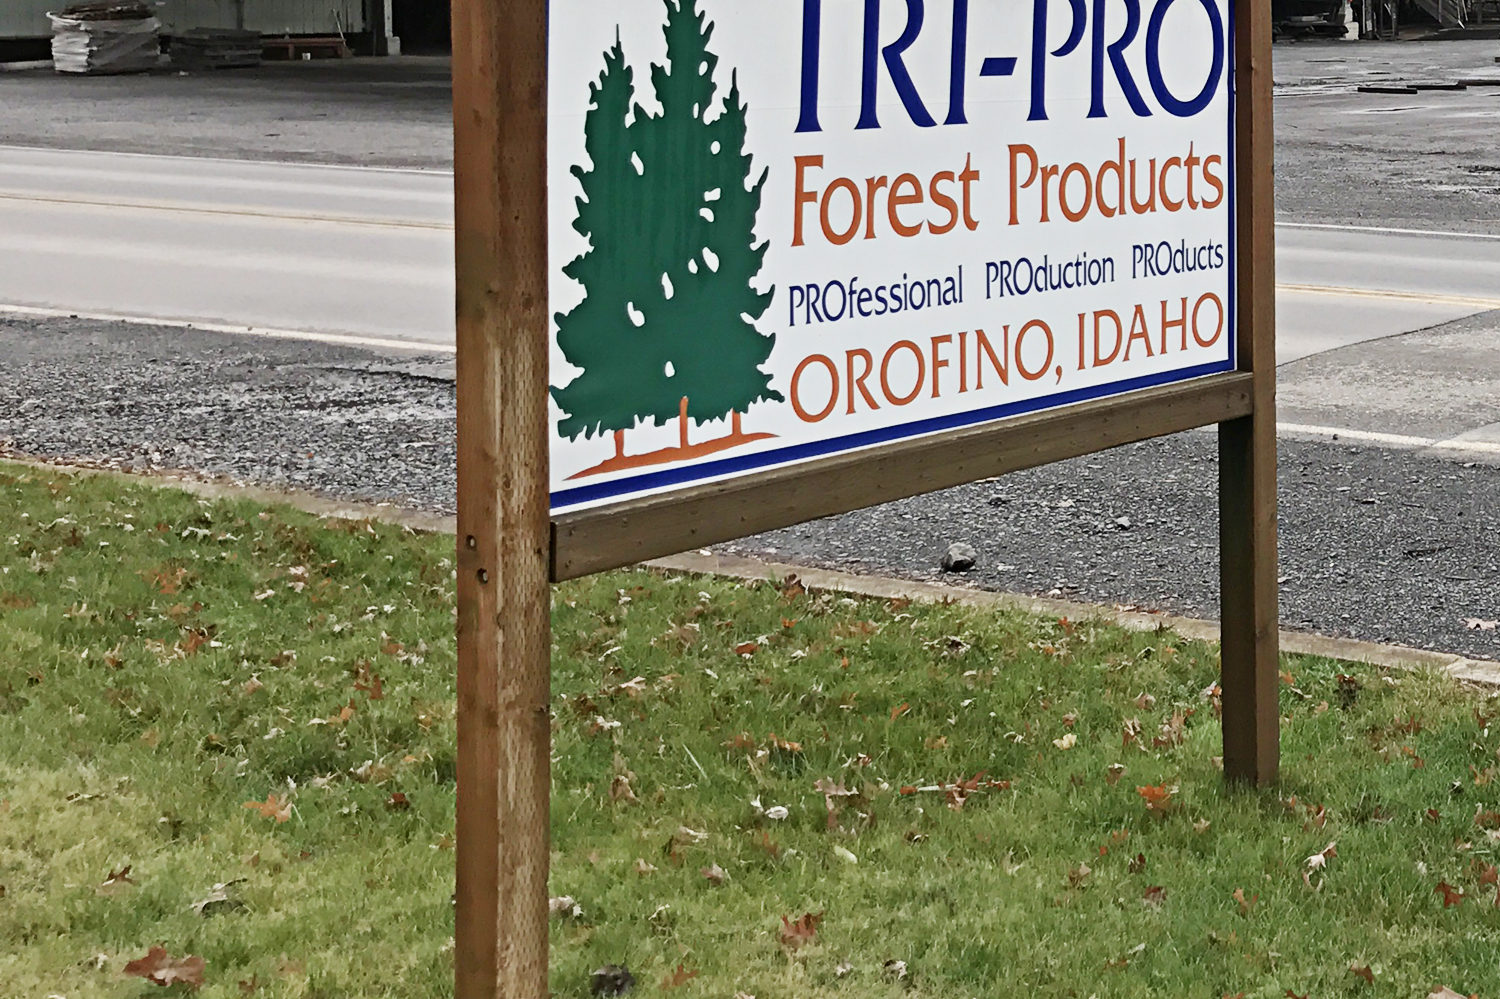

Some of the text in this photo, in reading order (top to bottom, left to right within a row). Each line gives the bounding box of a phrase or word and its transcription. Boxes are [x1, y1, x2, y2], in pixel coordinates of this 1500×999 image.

[792, 137, 1223, 246] Forest Products
[788, 239, 1224, 327] PROfessional PROduction PROducts
[790, 292, 1223, 422] OROFINO, IDAHO
